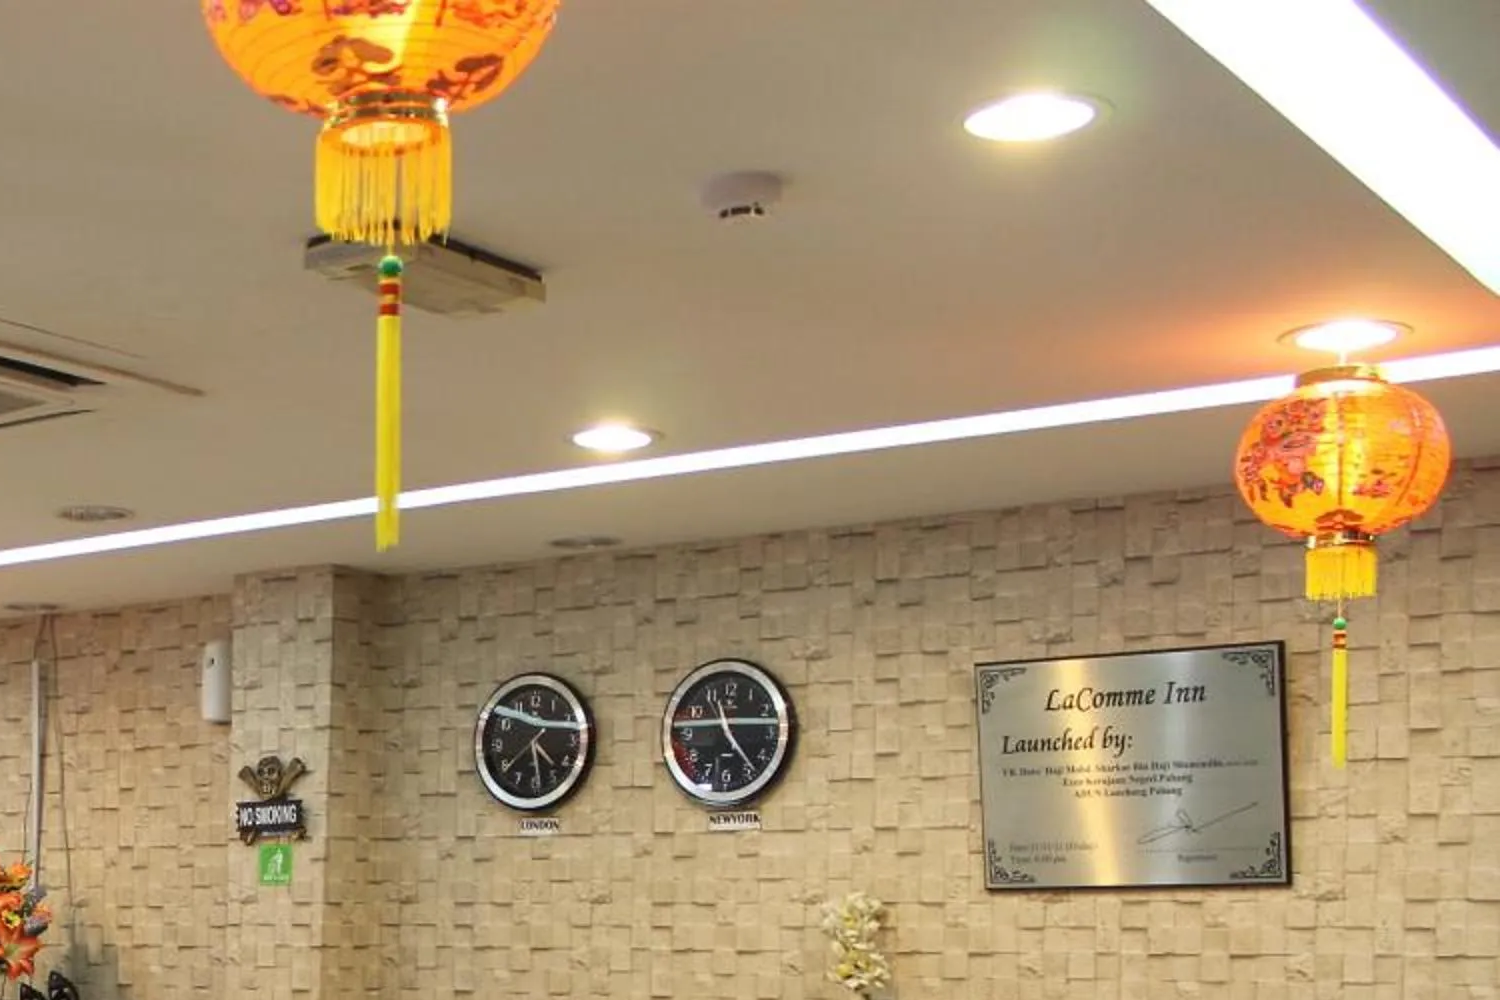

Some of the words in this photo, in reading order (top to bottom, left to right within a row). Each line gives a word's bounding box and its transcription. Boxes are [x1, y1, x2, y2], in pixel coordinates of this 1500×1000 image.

[725, 683, 738, 696] 12
[1044, 687, 1155, 712] LaComme
[1163, 681, 1206, 705] Inn
[1002, 728, 1096, 755] Launched
[1101, 725, 1134, 759] by:
[240, 807, 254, 827] NO
[255, 804, 297, 825] SMOKING
[709, 812, 761, 825] NEWYORK
[522, 820, 560, 830] LONDON
